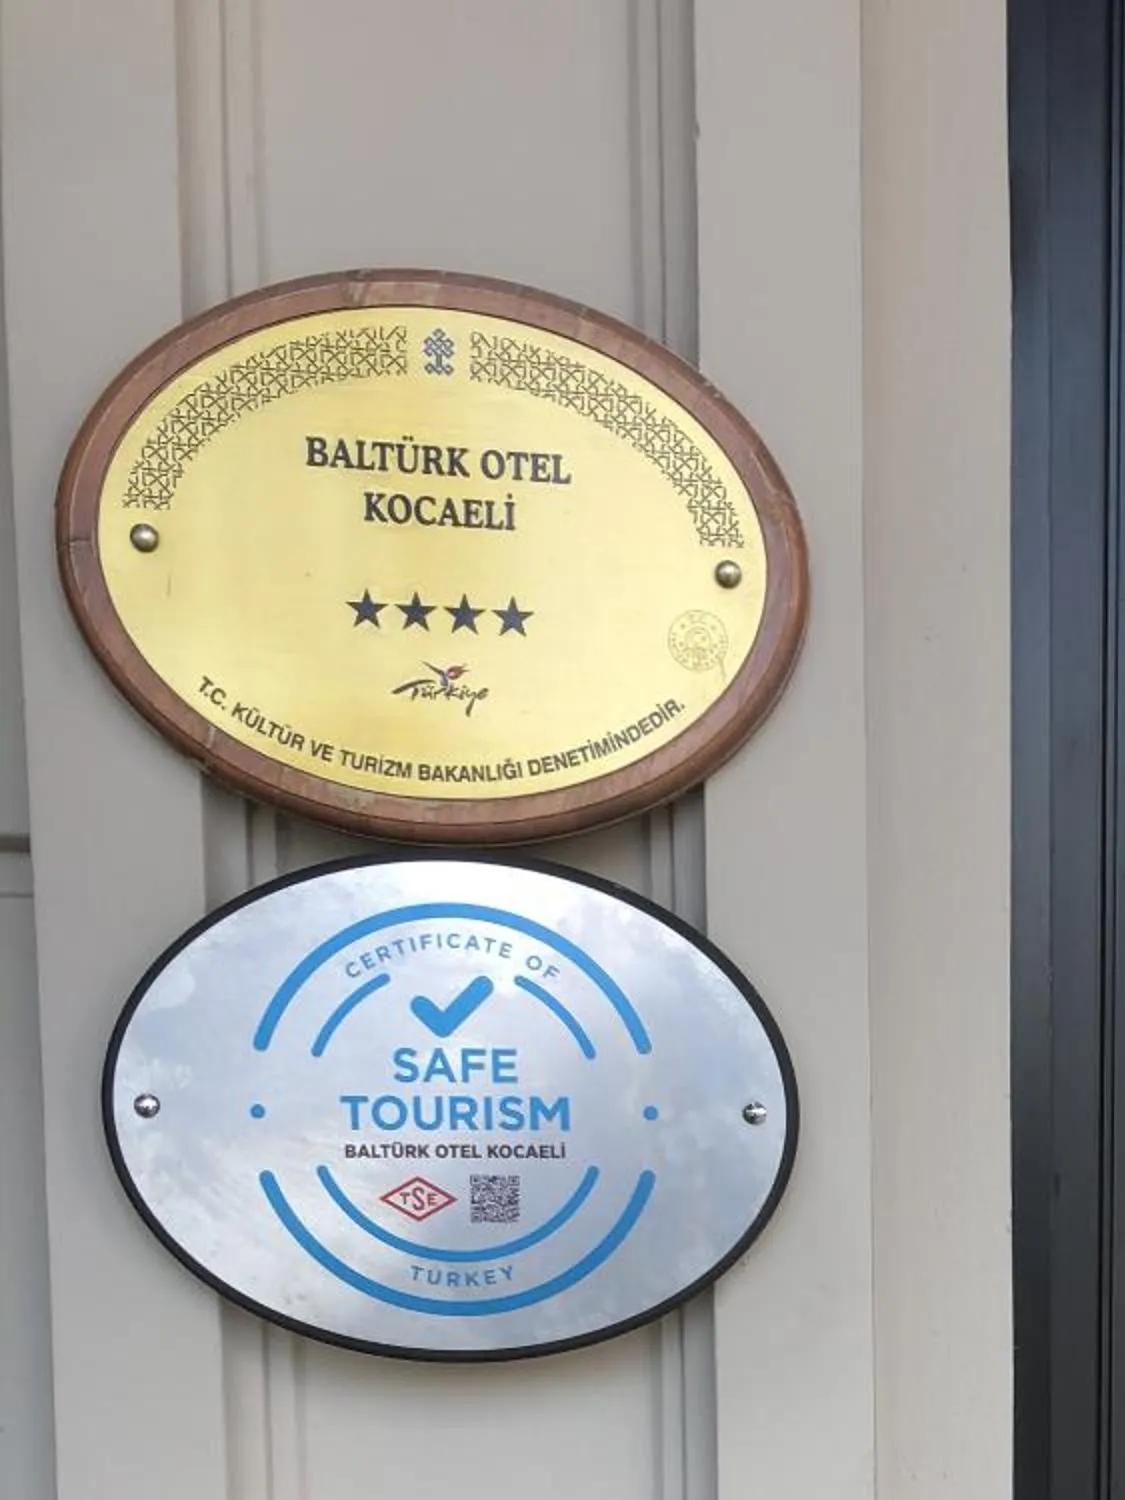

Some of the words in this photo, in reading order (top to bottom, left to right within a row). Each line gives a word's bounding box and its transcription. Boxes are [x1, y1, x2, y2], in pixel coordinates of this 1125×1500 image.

[305, 435, 470, 478] BALTÜRK
[480, 449, 572, 484] OTEL
[363, 493, 516, 531] KOCAELİ
[391, 678, 489, 717] Türkiye
[197, 675, 227, 711] T.C.
[231, 702, 305, 752] KÜLTÜR
[310, 739, 335, 763] VE
[340, 748, 413, 780] TURİZM
[418, 757, 523, 783] BAKANLIĞI
[528, 698, 686, 776] DENETİMİNDEDİR.
[345, 933, 514, 979] CERTIFICATE
[525, 955, 561, 980] OF
[393, 1047, 519, 1084] SAFE
[340, 1094, 571, 1132] TOURISM
[345, 1141, 430, 1159] BALTÜRK
[435, 1143, 483, 1159] OTEL
[487, 1142, 566, 1159] KOCAELİ
[400, 1186, 438, 1211] TSE
[410, 1264, 513, 1288] TURKEY
